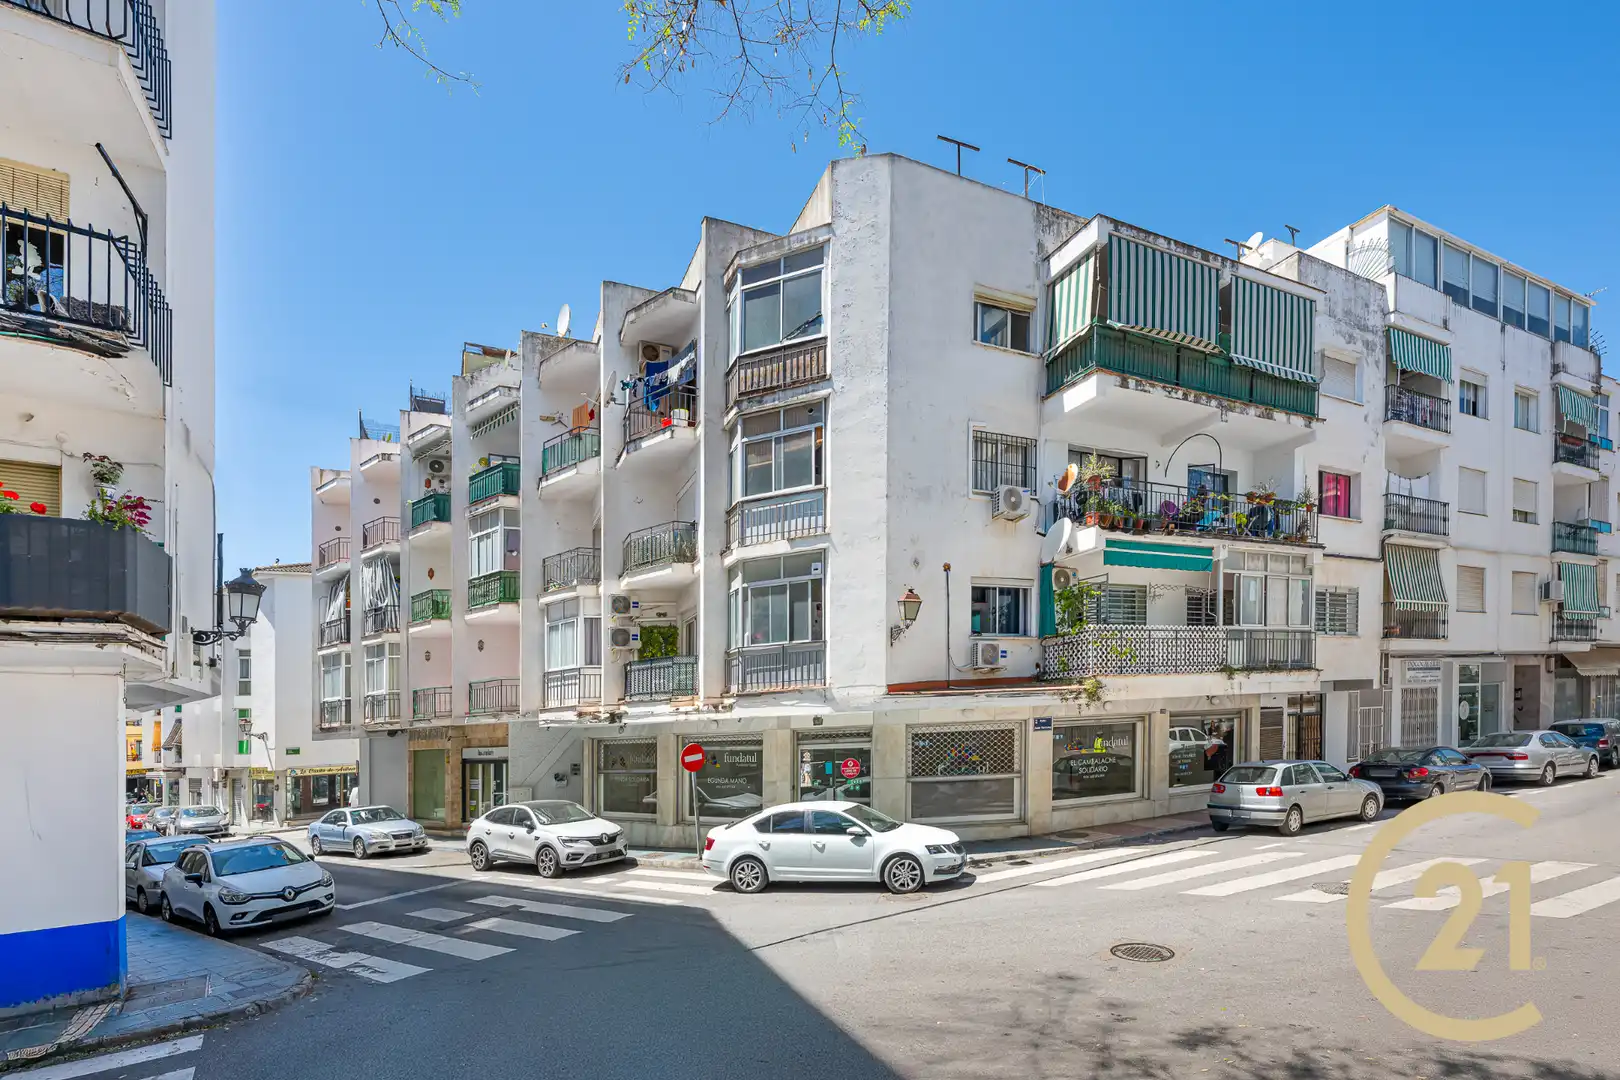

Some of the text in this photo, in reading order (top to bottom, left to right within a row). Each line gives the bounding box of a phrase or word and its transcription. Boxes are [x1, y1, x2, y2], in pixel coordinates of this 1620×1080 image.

[724, 752, 757, 763] fundatul
[1077, 757, 1117, 765] CAMBALACHE
[1078, 765, 1108, 774] SOLIDARIO
